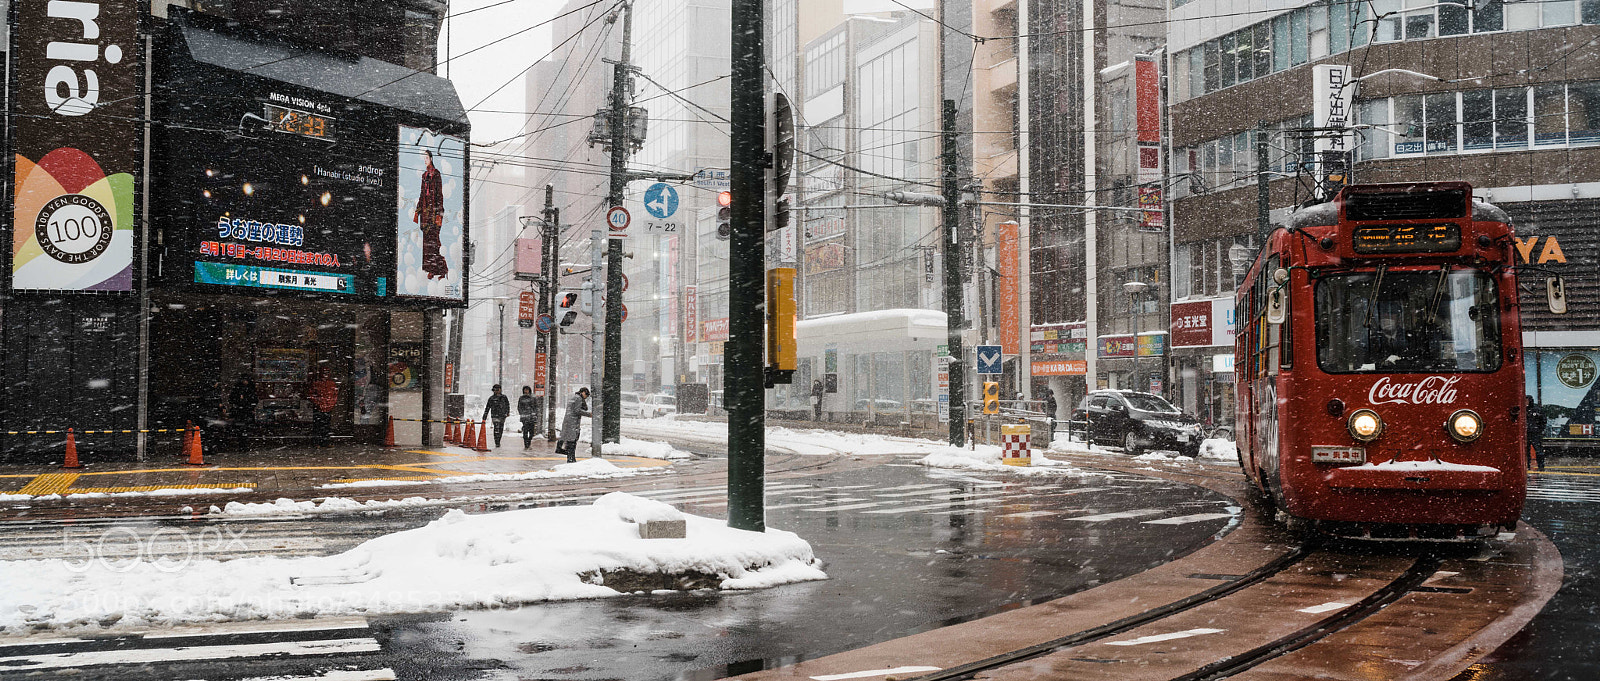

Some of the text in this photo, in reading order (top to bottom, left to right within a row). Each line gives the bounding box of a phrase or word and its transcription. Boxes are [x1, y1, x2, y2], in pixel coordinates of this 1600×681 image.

[45, 0, 122, 116] ria
[270, 92, 290, 103] MEGA
[291, 97, 315, 109] VISION
[358, 165, 384, 177] androp
[39, 197, 106, 228] 100 YEN GOODS
[611, 214, 626, 224] 40
[50, 216, 97, 243] 100
[218, 216, 304, 246] うお座の運勢
[41, 226, 111, 262] COLOR THE DAYS
[225, 268, 257, 281] 詳しくは
[1183, 315, 1207, 329] 玉光堂
[1369, 376, 1462, 405] Coca-Cola
